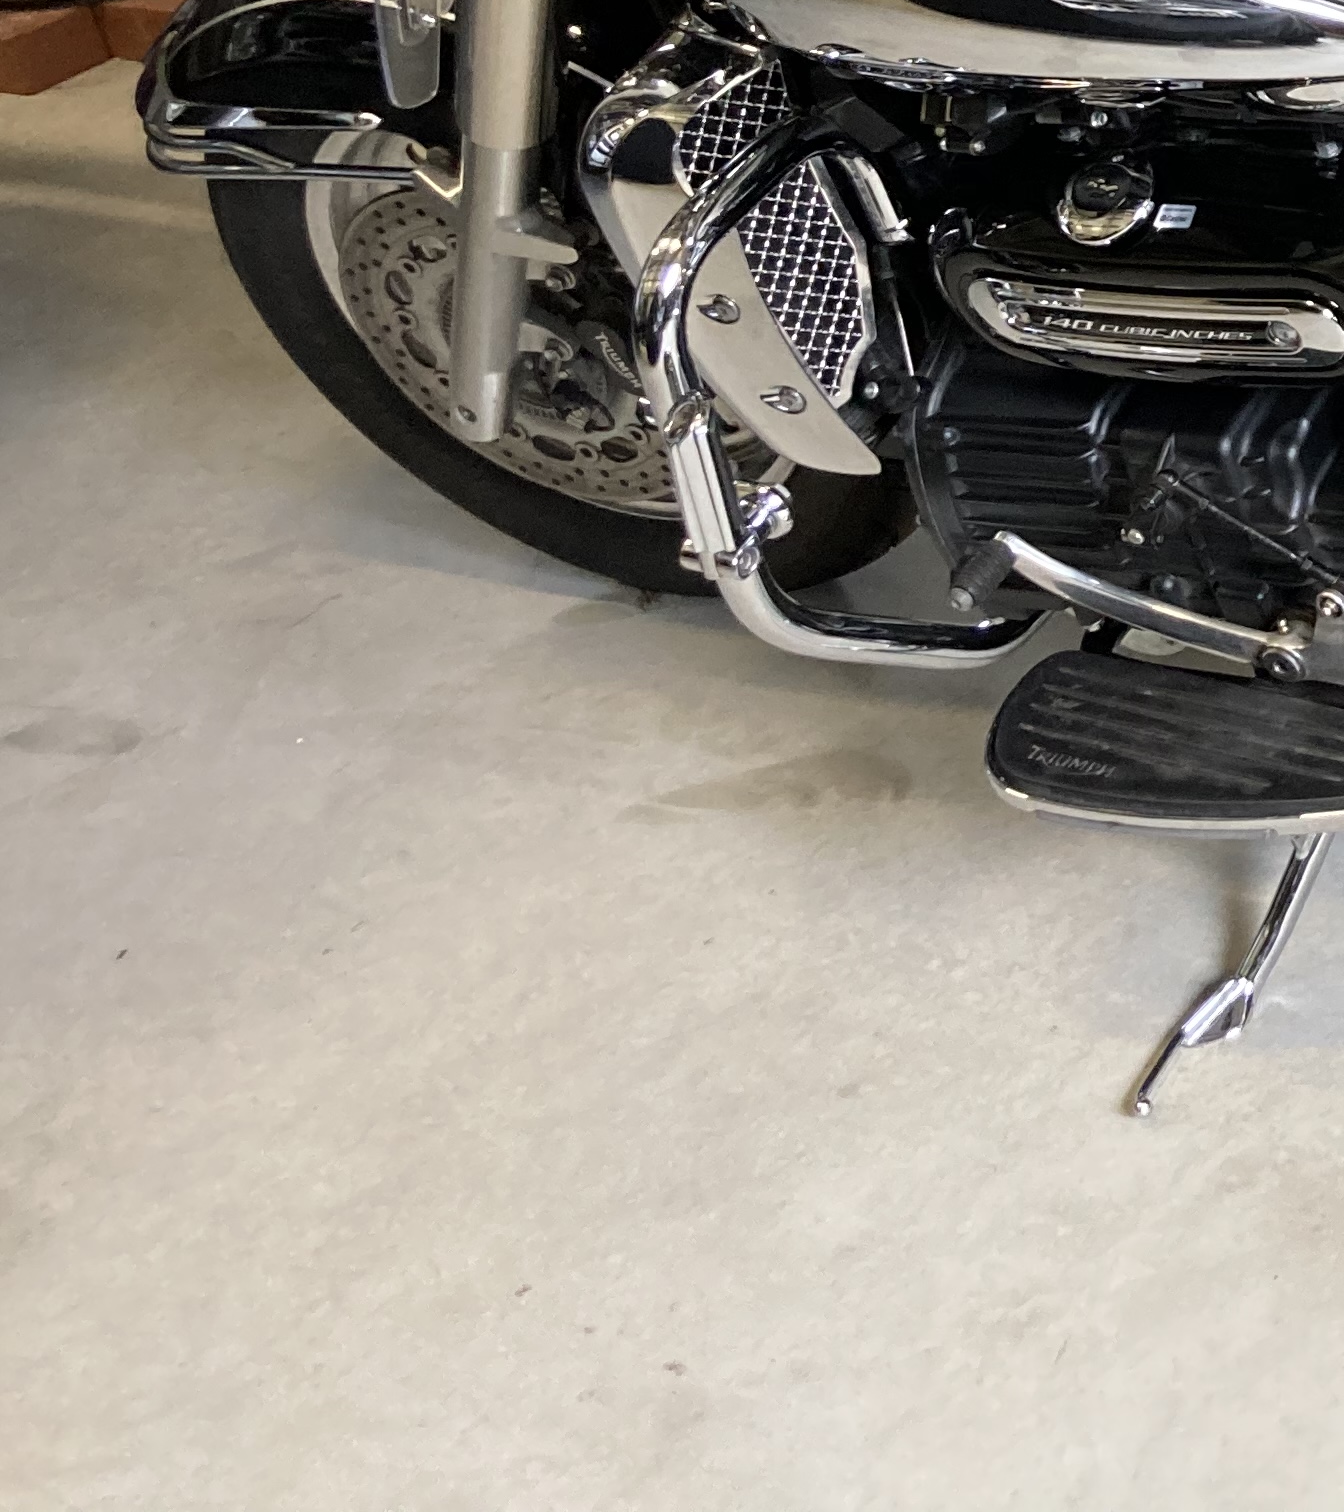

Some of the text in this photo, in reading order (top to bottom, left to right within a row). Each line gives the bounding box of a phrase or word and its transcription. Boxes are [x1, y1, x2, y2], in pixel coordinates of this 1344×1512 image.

[1043, 316, 1254, 341] 140 CUBIC INCHES
[595, 332, 642, 388] TRIUMPH
[1027, 744, 1116, 778] TRIUMPH
